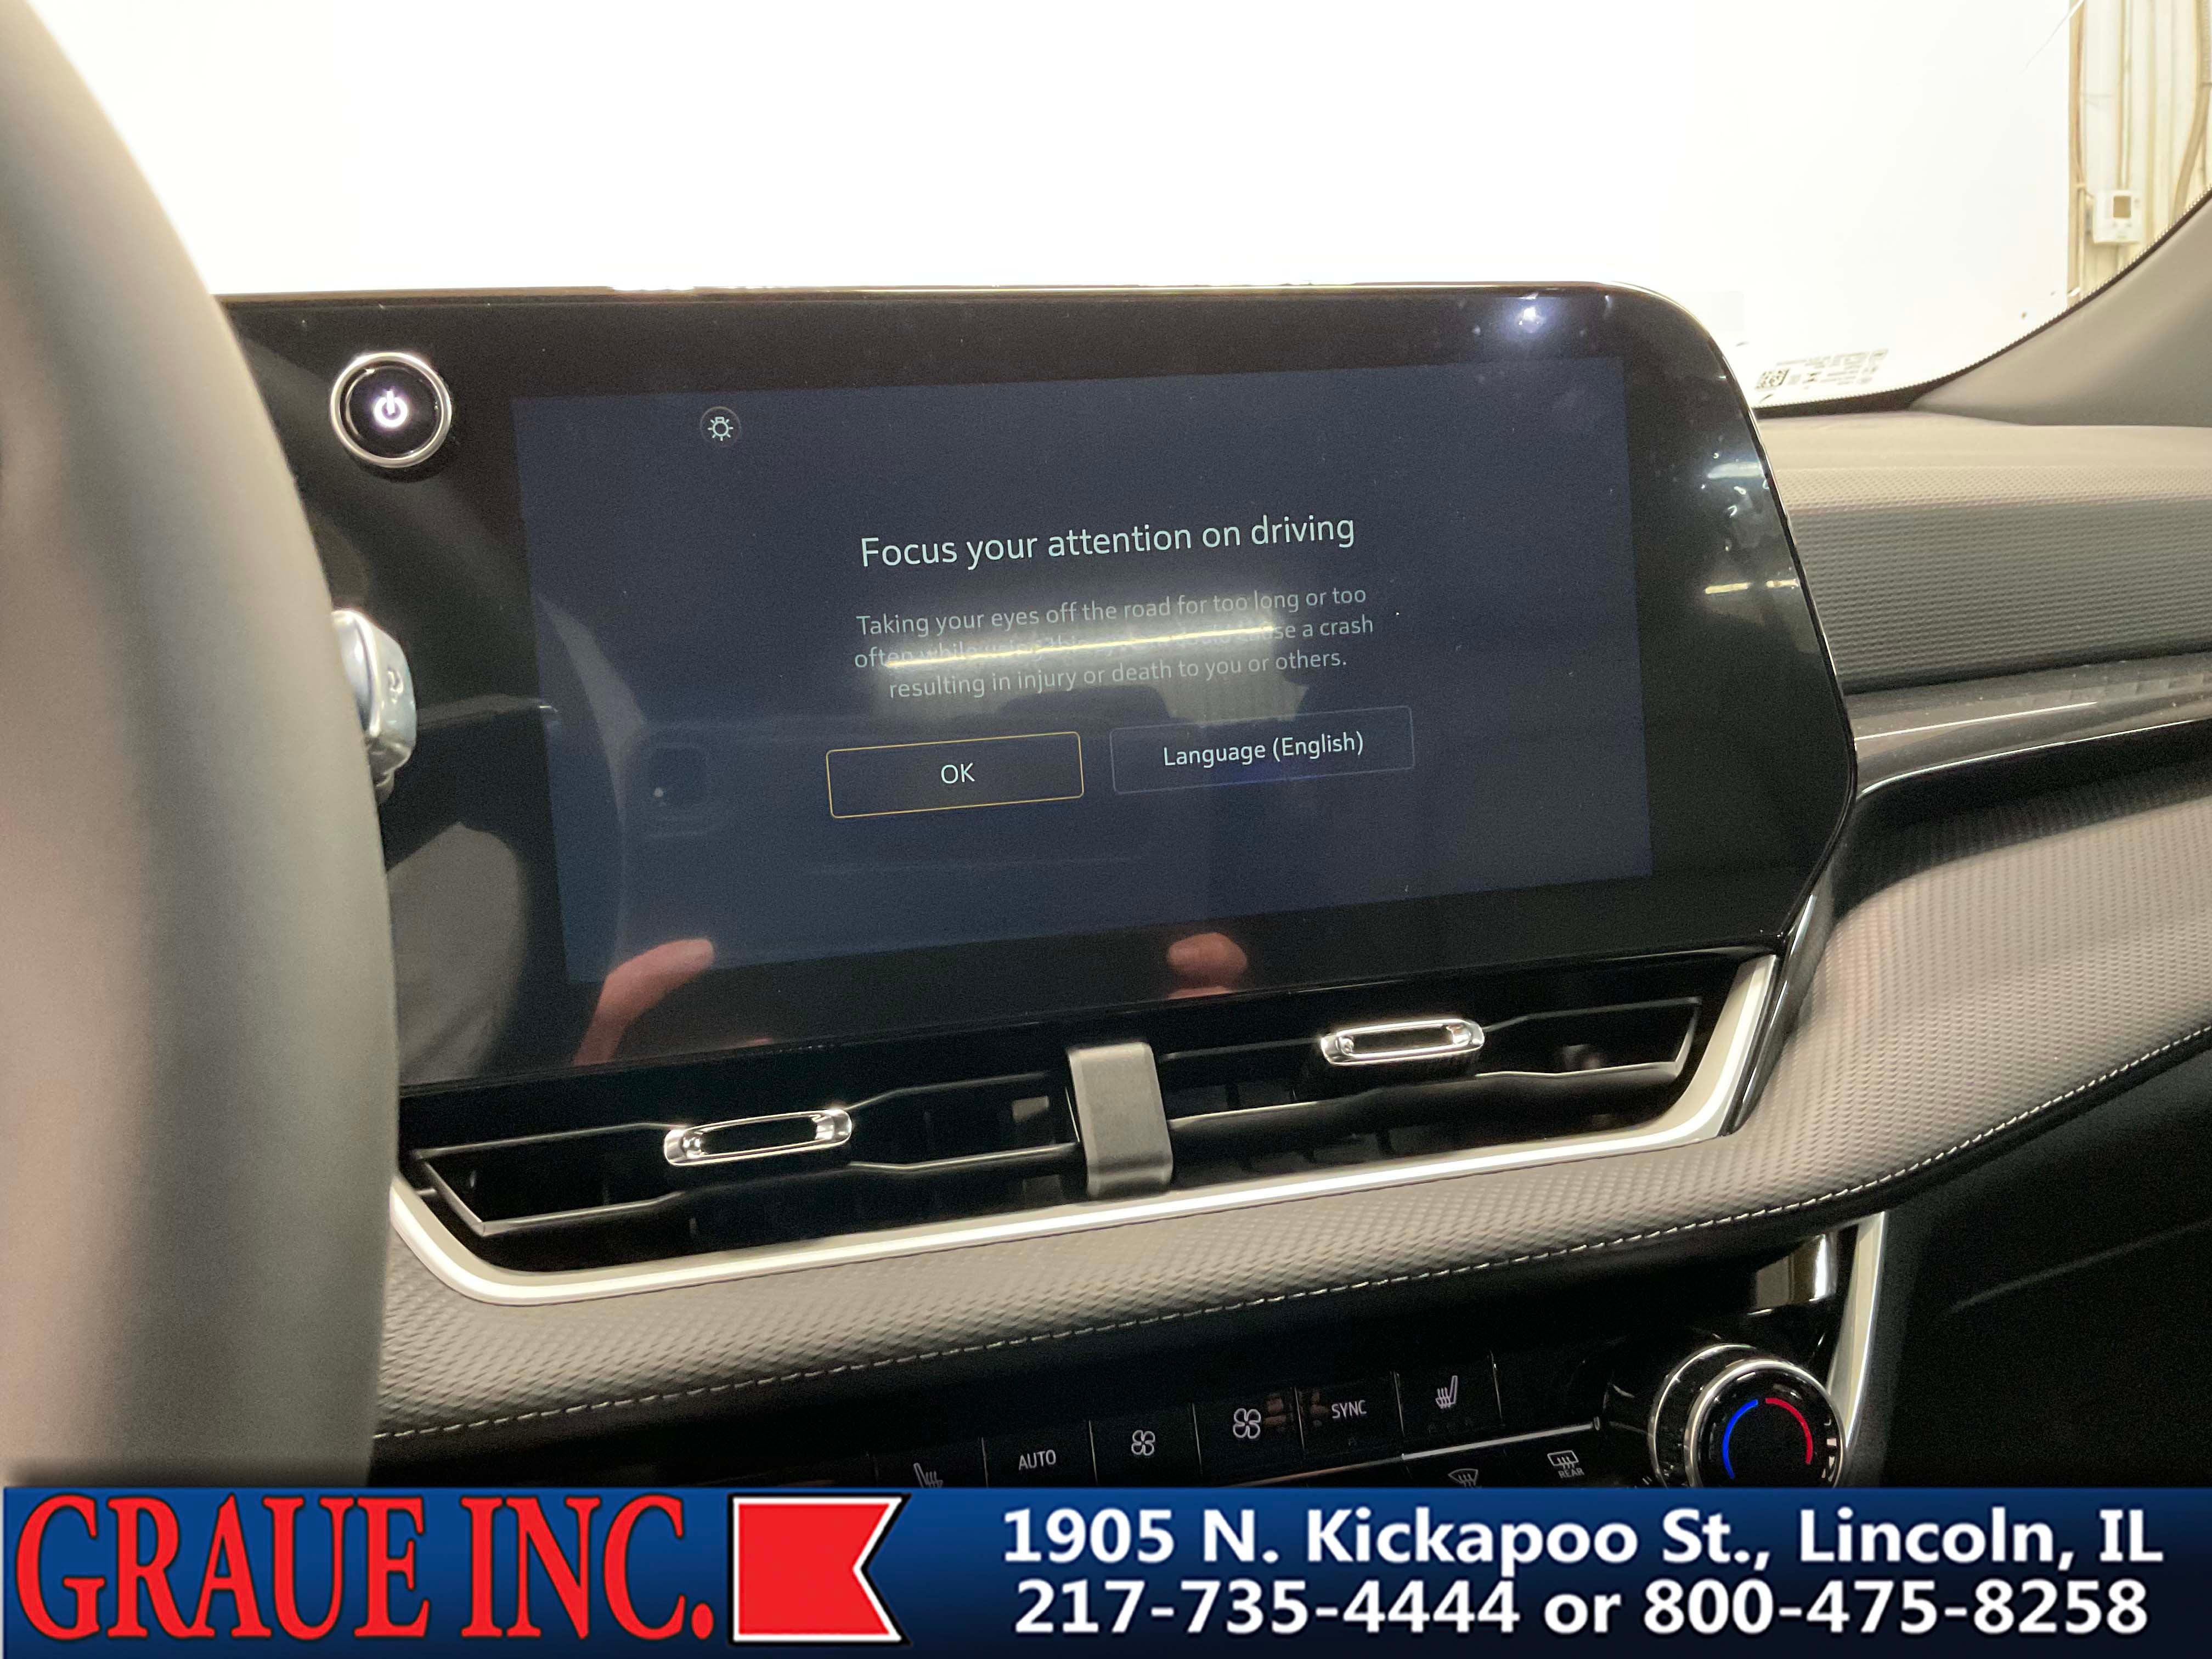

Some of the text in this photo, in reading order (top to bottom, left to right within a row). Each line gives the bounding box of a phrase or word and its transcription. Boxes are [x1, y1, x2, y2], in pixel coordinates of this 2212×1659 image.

[861, 514, 1355, 571] Focus your attention on driving
[856, 587, 1367, 637] Taking your eyes off the road for too long or too
[854, 646, 913, 668] often
[1302, 623, 1314, 638] a
[1320, 614, 1374, 636] crash
[889, 650, 1347, 698] resulting in injury or death to you or others.
[1163, 731, 1364, 769] Language (English)
[940, 763, 975, 785] OK
[1331, 1400, 1368, 1419] SYNC
[1018, 1449, 1057, 1471] AUTO
[1558, 1468, 1585, 1479] REAR
